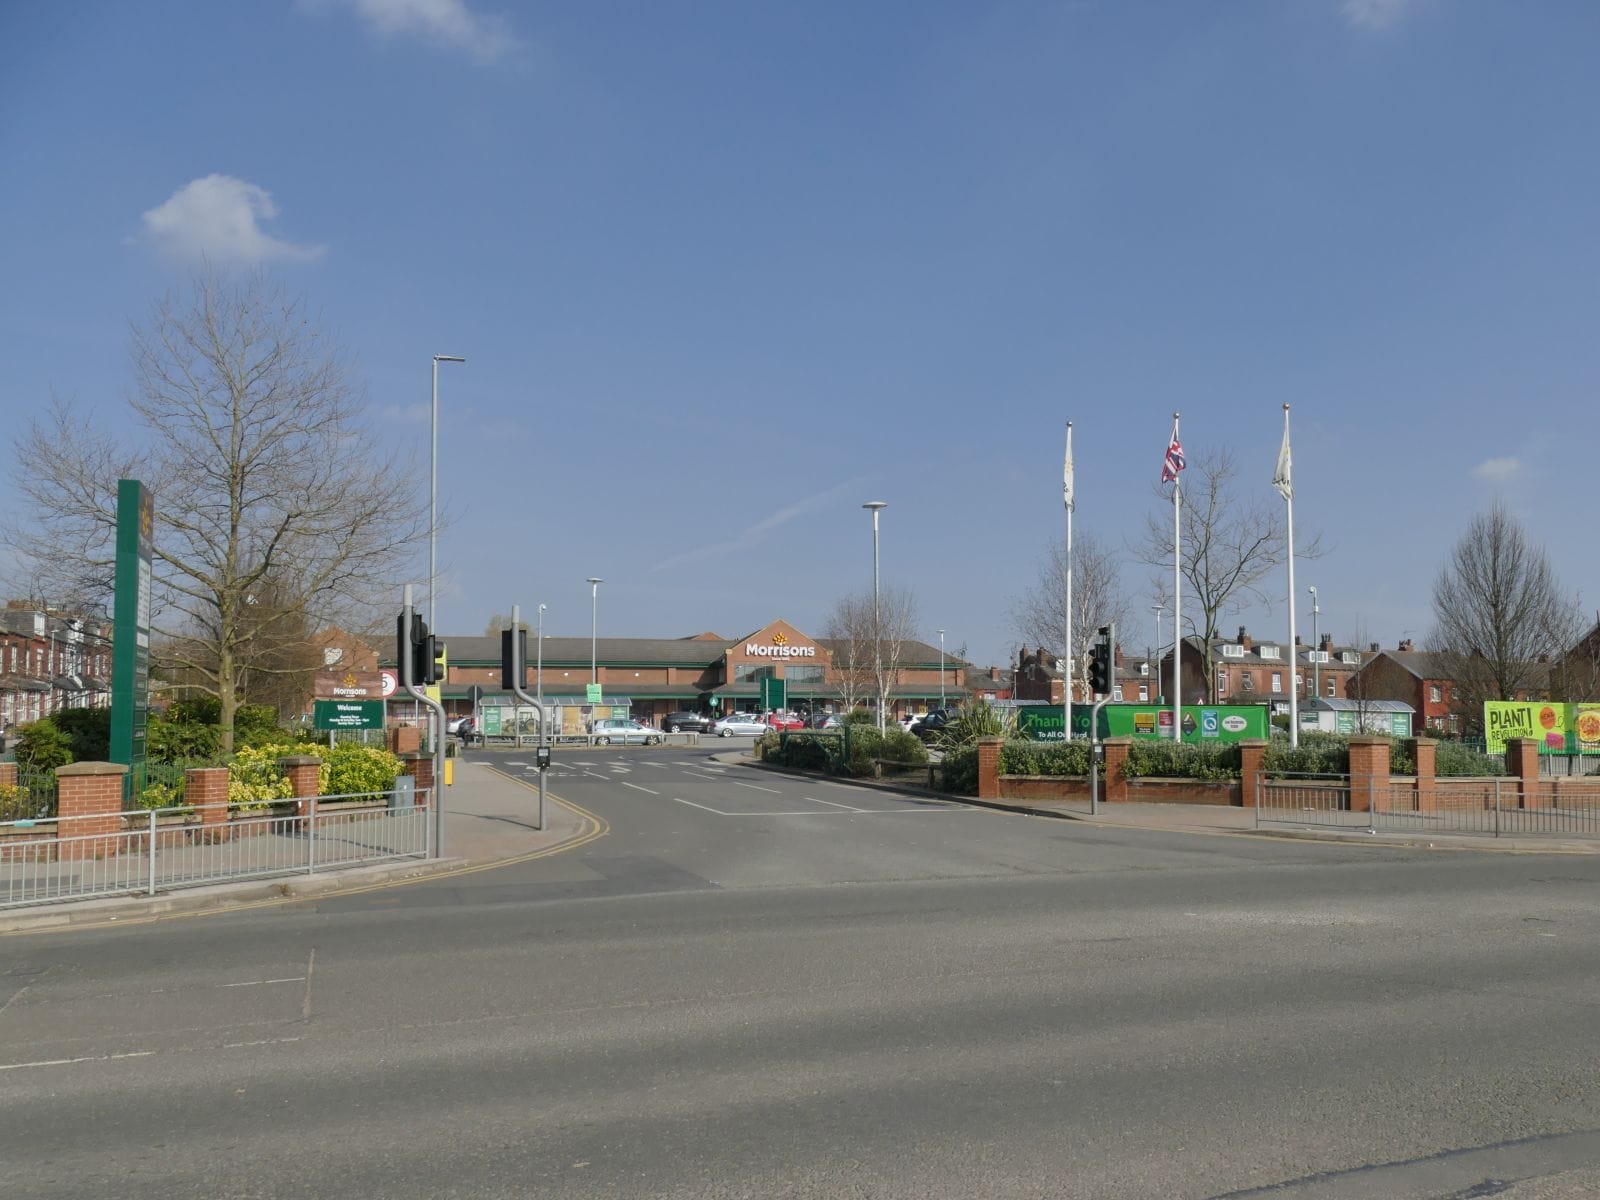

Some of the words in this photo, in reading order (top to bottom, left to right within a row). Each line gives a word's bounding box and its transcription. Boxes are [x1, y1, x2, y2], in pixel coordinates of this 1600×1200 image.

[746, 643, 815, 656] Morrisons
[334, 687, 366, 695] Morrisons
[1491, 728, 1528, 741] REVOLUTION
